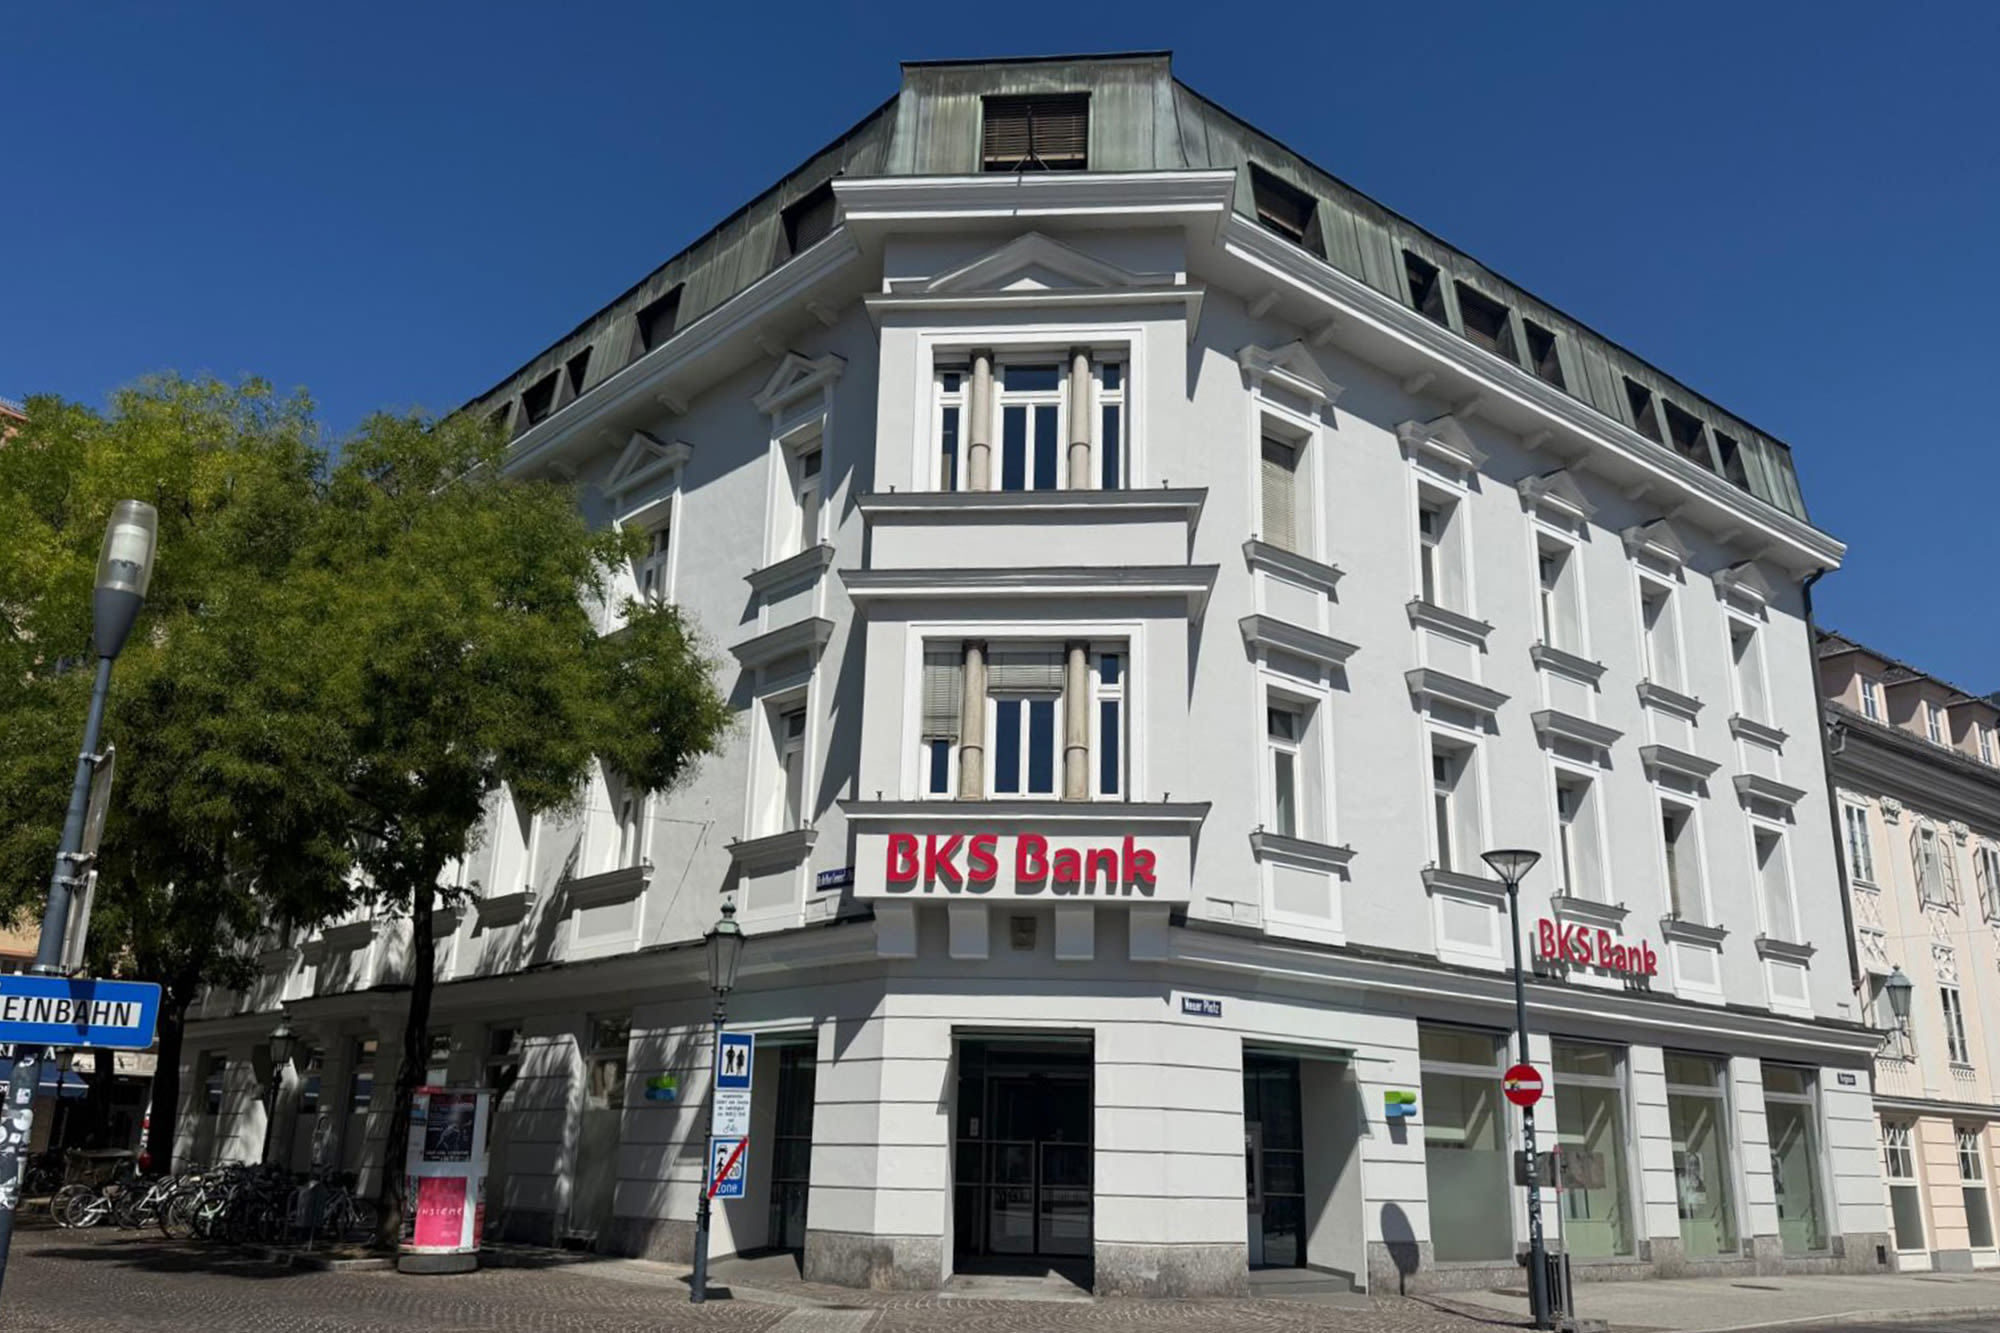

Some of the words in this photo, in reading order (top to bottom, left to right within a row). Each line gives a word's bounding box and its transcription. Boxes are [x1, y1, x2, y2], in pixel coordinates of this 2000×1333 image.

[886, 833, 999, 884] BKS
[1015, 833, 1157, 885] Bank
[1538, 918, 1592, 966] BKS
[1597, 928, 1658, 976] Bank
[2, 996, 132, 1027] EINBAHN
